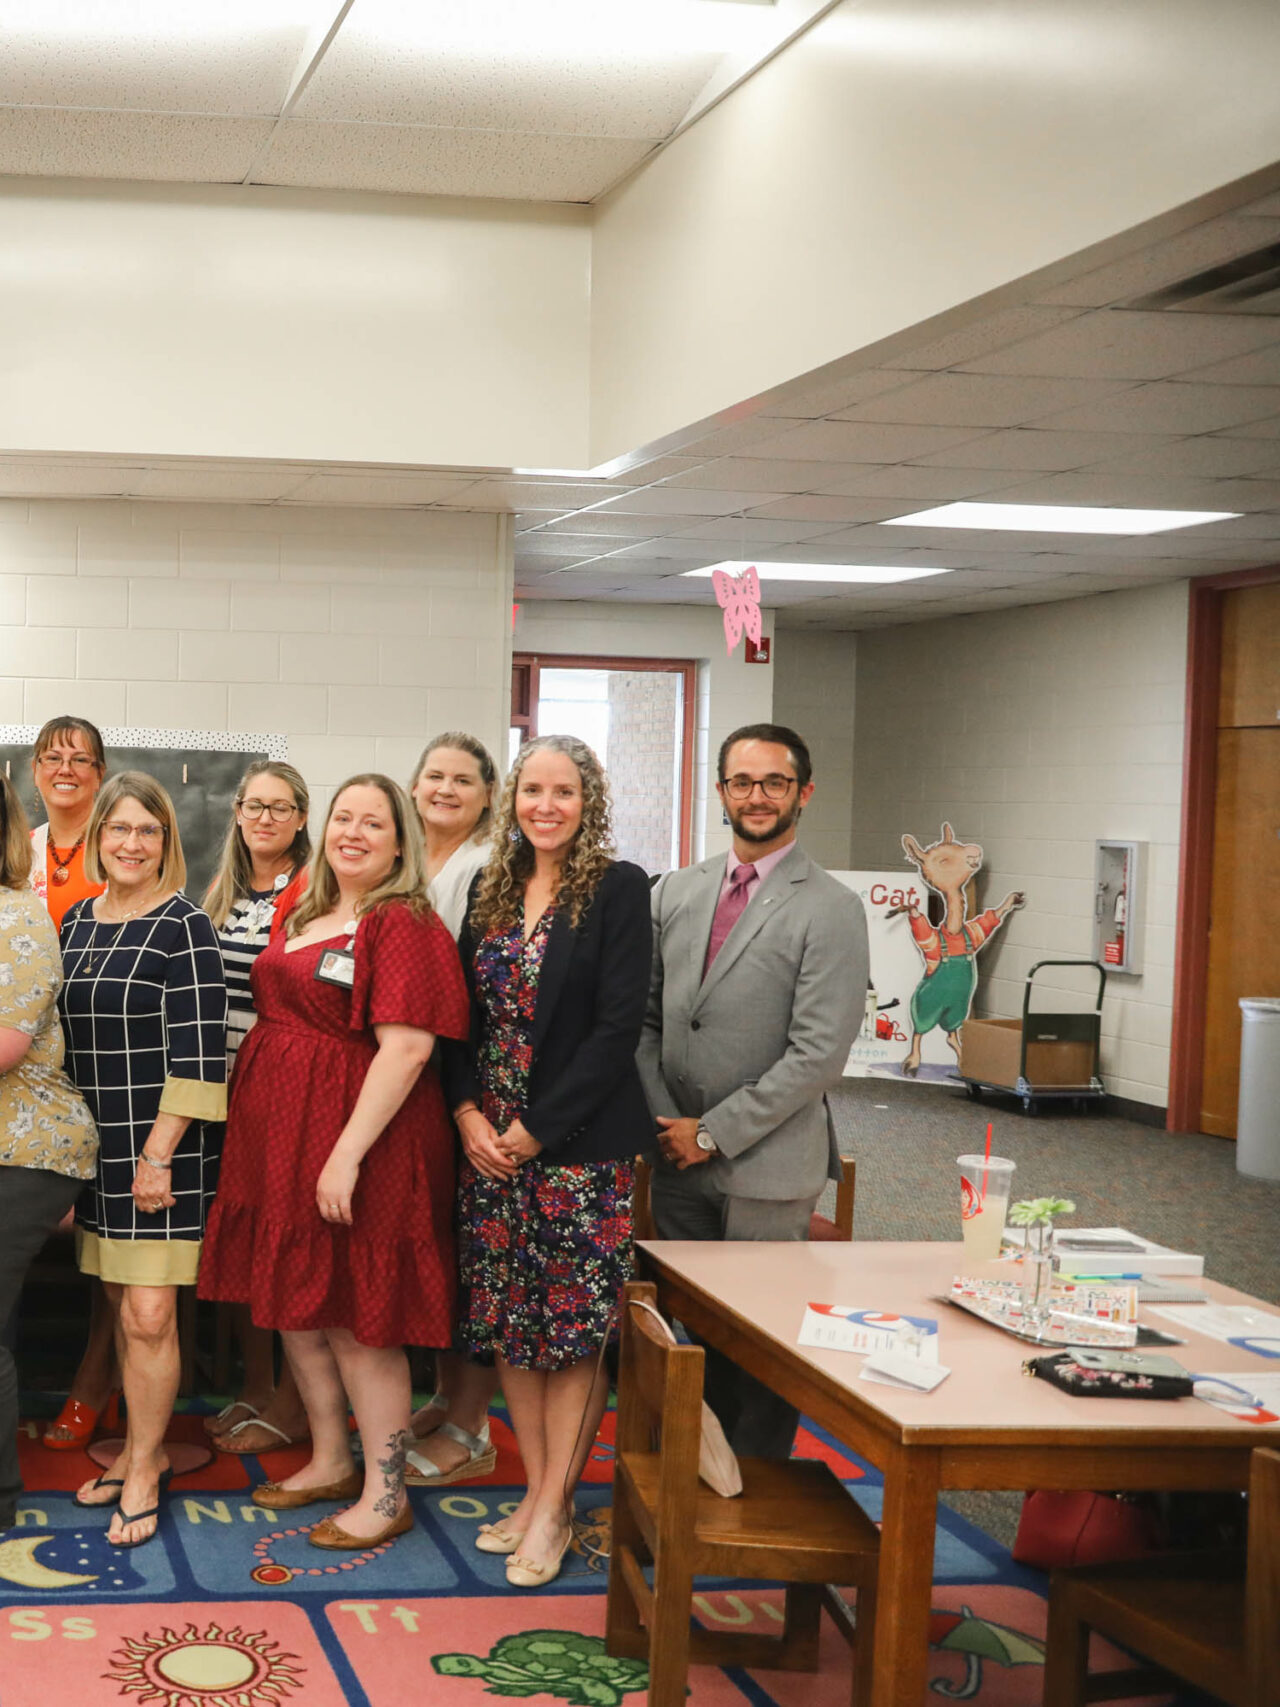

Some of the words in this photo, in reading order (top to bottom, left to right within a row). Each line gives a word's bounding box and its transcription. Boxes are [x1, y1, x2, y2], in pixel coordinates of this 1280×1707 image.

[870, 883, 921, 906] Cat
[183, 1500, 278, 1524] Nn
[8, 1610, 97, 1641] Ss
[339, 1603, 421, 1633] Tt
